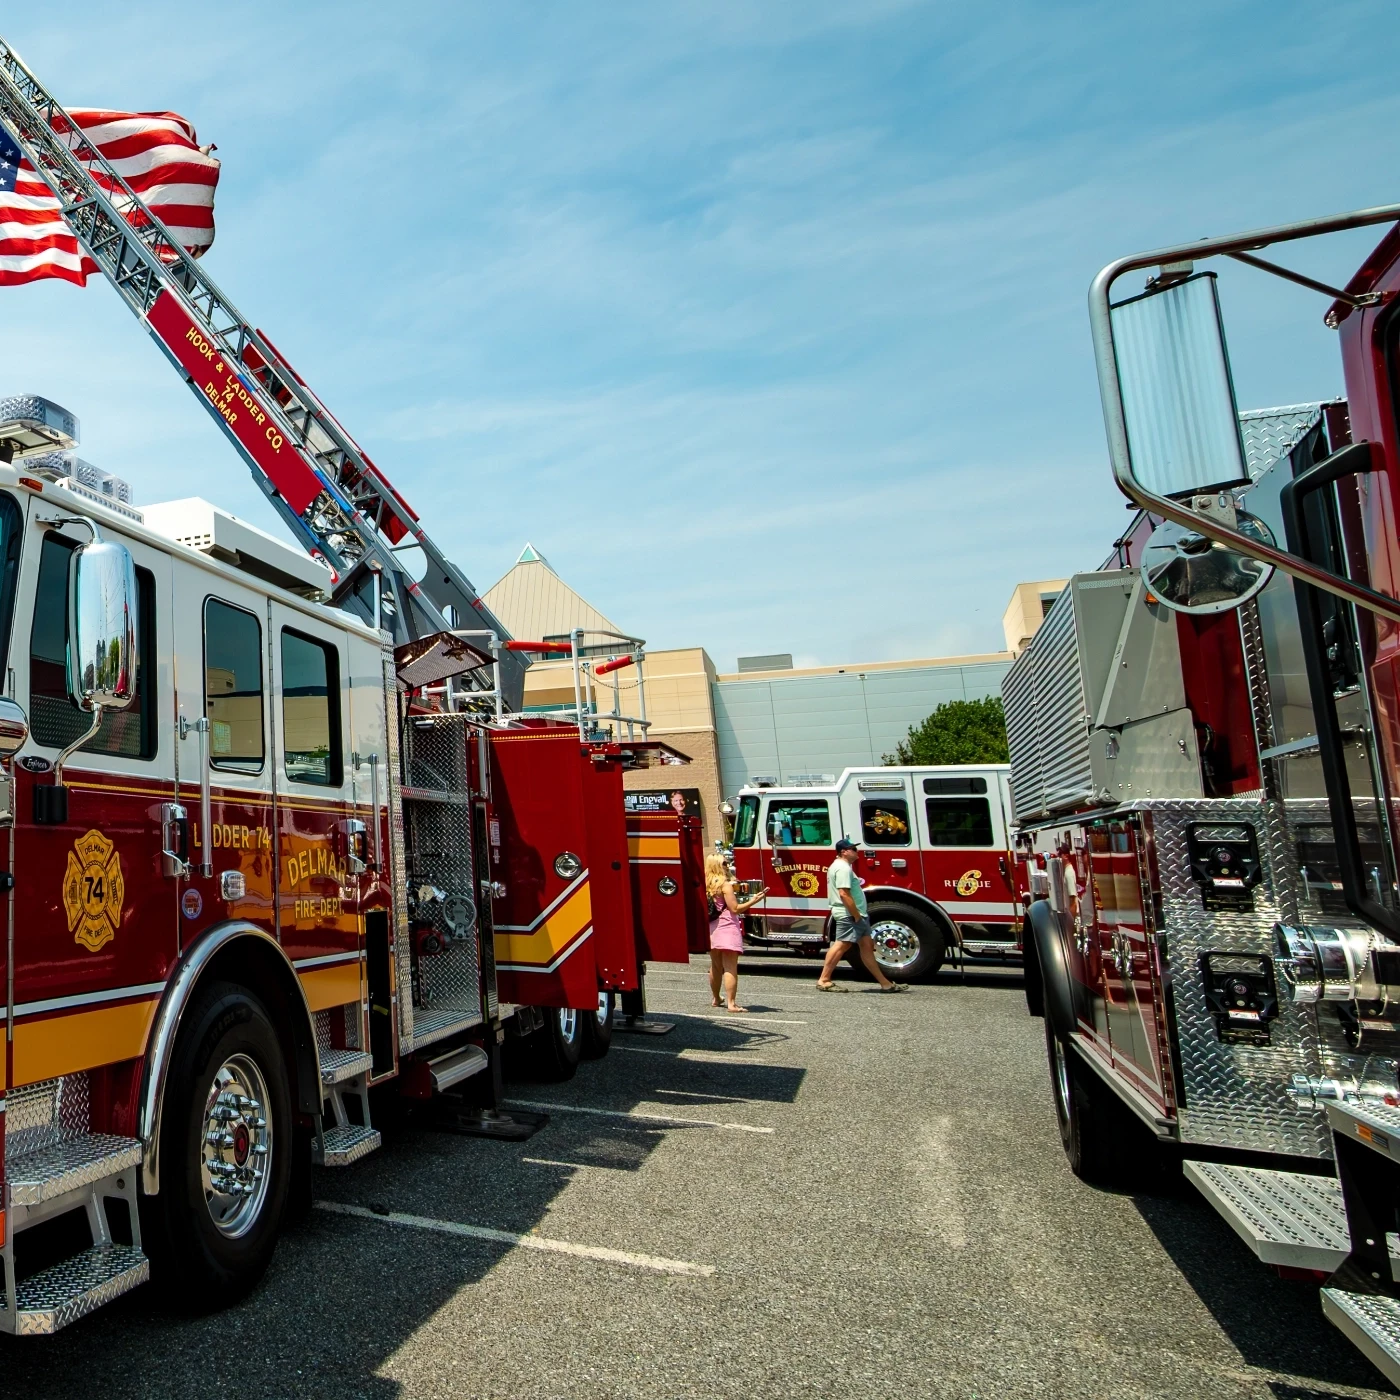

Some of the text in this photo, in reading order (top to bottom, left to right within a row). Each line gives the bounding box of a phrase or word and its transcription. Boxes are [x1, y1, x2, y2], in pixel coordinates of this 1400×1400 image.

[186, 327, 282, 453] HOOK & LADDER CO.
[221, 386, 235, 402] 74
[205, 382, 238, 425] DELMAR
[639, 794, 667, 804] Engvall
[194, 823, 270, 849] LDDER 74
[85, 844, 104, 855] DELMAR
[287, 848, 347, 886] DELMAR
[774, 864, 801, 873] BERLIN
[84, 876, 104, 903] 74
[944, 880, 991, 888] REUE
[957, 870, 982, 896] 6
[295, 897, 344, 919] FIRE DEPT.
[84, 925, 93, 938] FIRE
